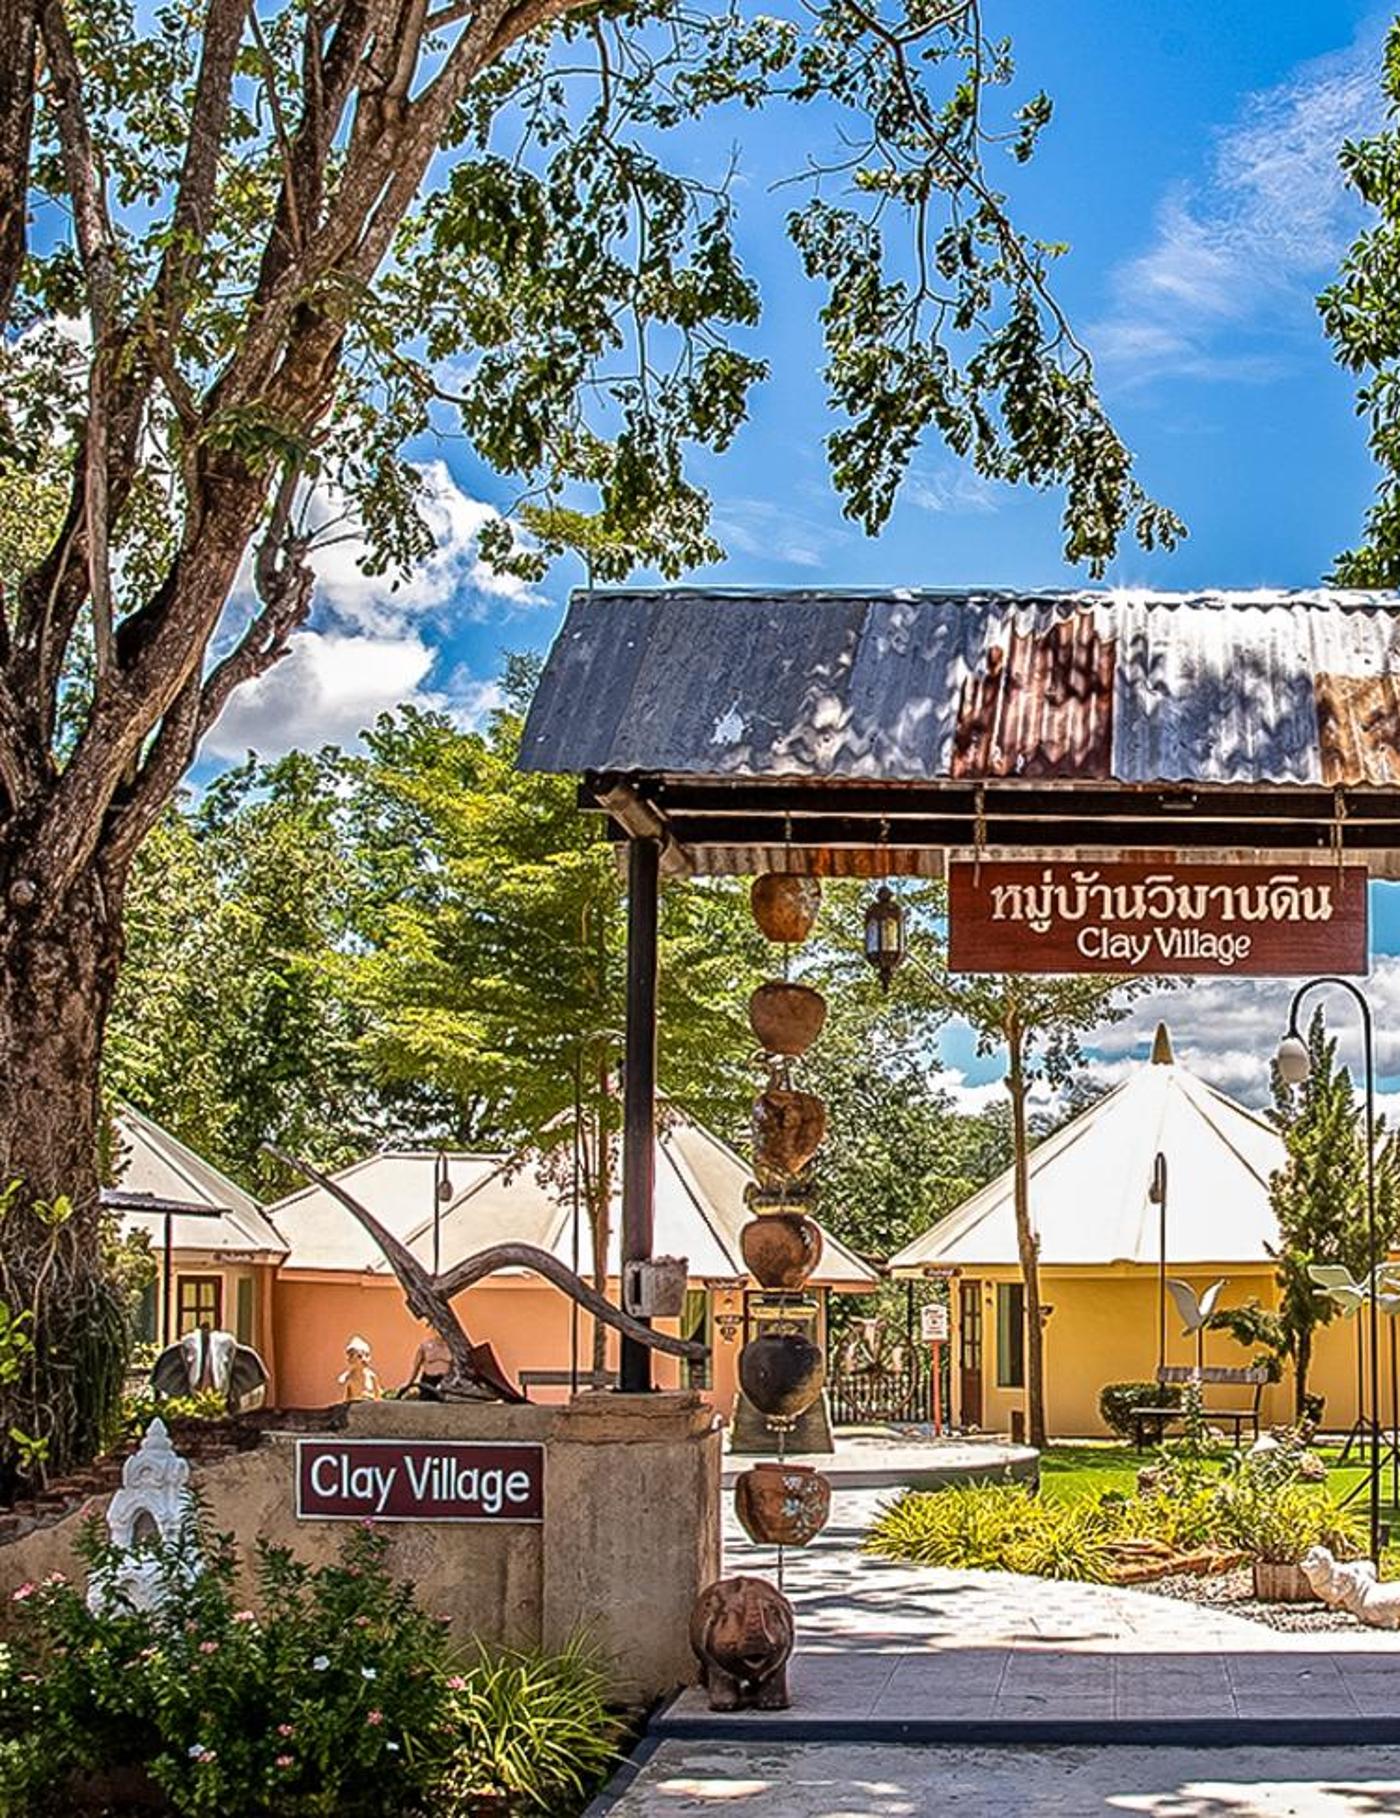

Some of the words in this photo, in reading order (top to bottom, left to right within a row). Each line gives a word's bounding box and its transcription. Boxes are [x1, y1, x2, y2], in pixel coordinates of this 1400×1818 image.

[990, 869, 1333, 933] หมู่บ้านวิมานดิน
[1077, 926, 1151, 966] Clay
[1154, 926, 1252, 966] Village
[311, 1454, 397, 1513] Clay
[404, 1456, 530, 1514] Village
